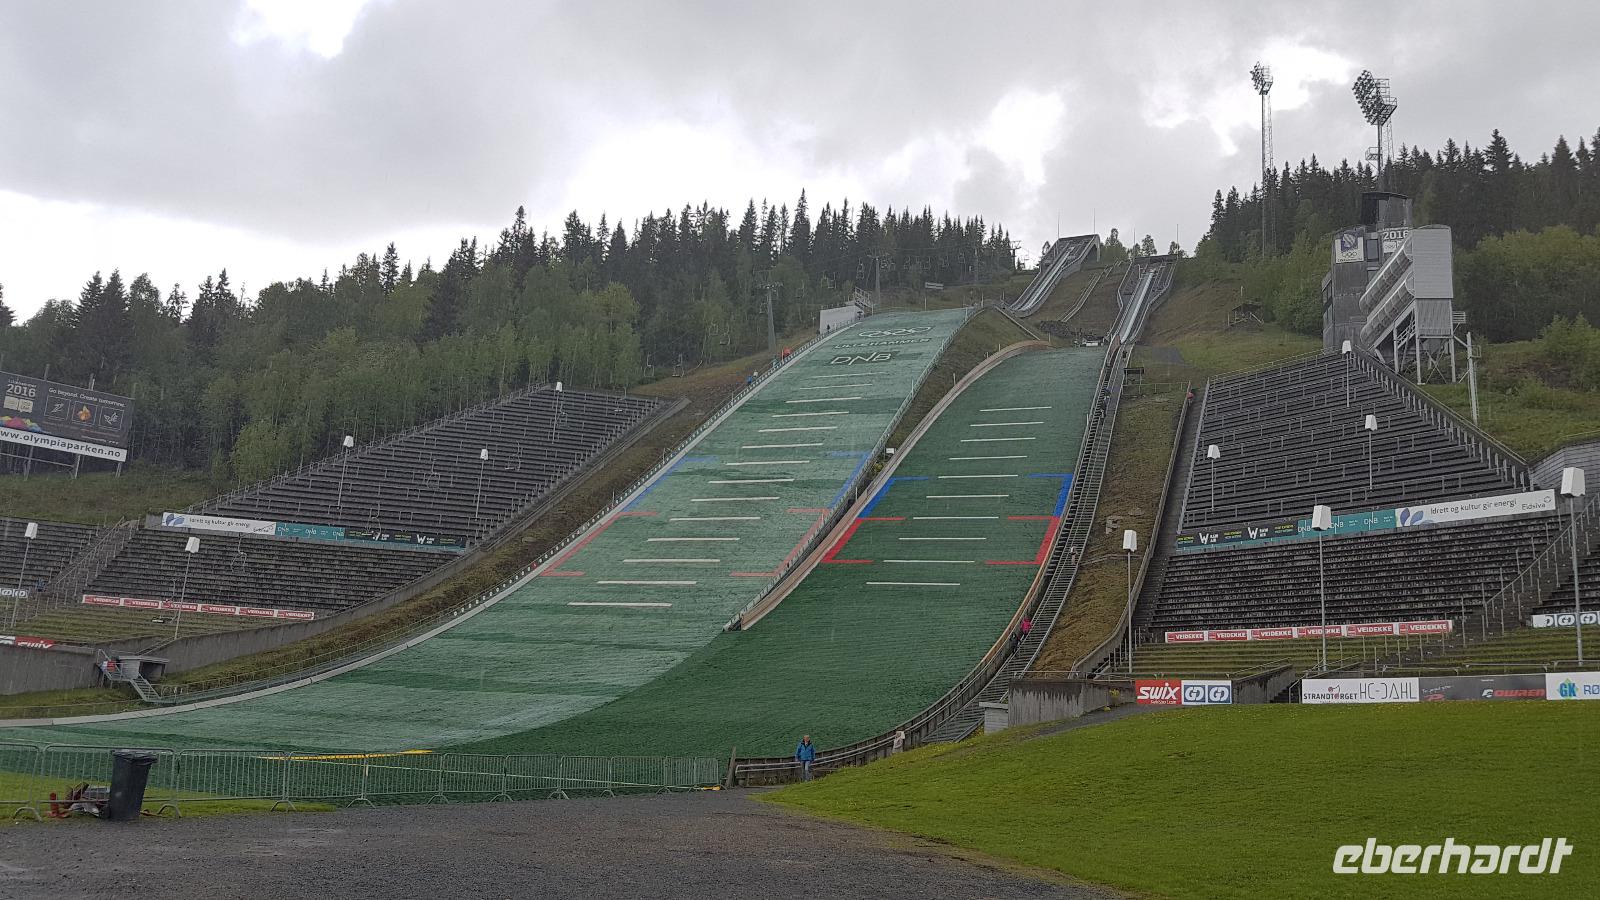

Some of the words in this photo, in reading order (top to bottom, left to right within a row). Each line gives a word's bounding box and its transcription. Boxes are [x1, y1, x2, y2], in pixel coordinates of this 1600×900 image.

[830, 352, 892, 365] DNB
[6, 384, 36, 398] 2016
[1430, 507, 1449, 515] Idrett
[1450, 506, 1459, 514] og
[1460, 503, 1482, 512] kultur
[1482, 502, 1493, 510] gir
[1494, 499, 1517, 508] energi
[1357, 625, 1393, 633] VEIDEKKE
[1410, 623, 1447, 631] VEIDEKKE
[1559, 683, 1576, 697] GK
